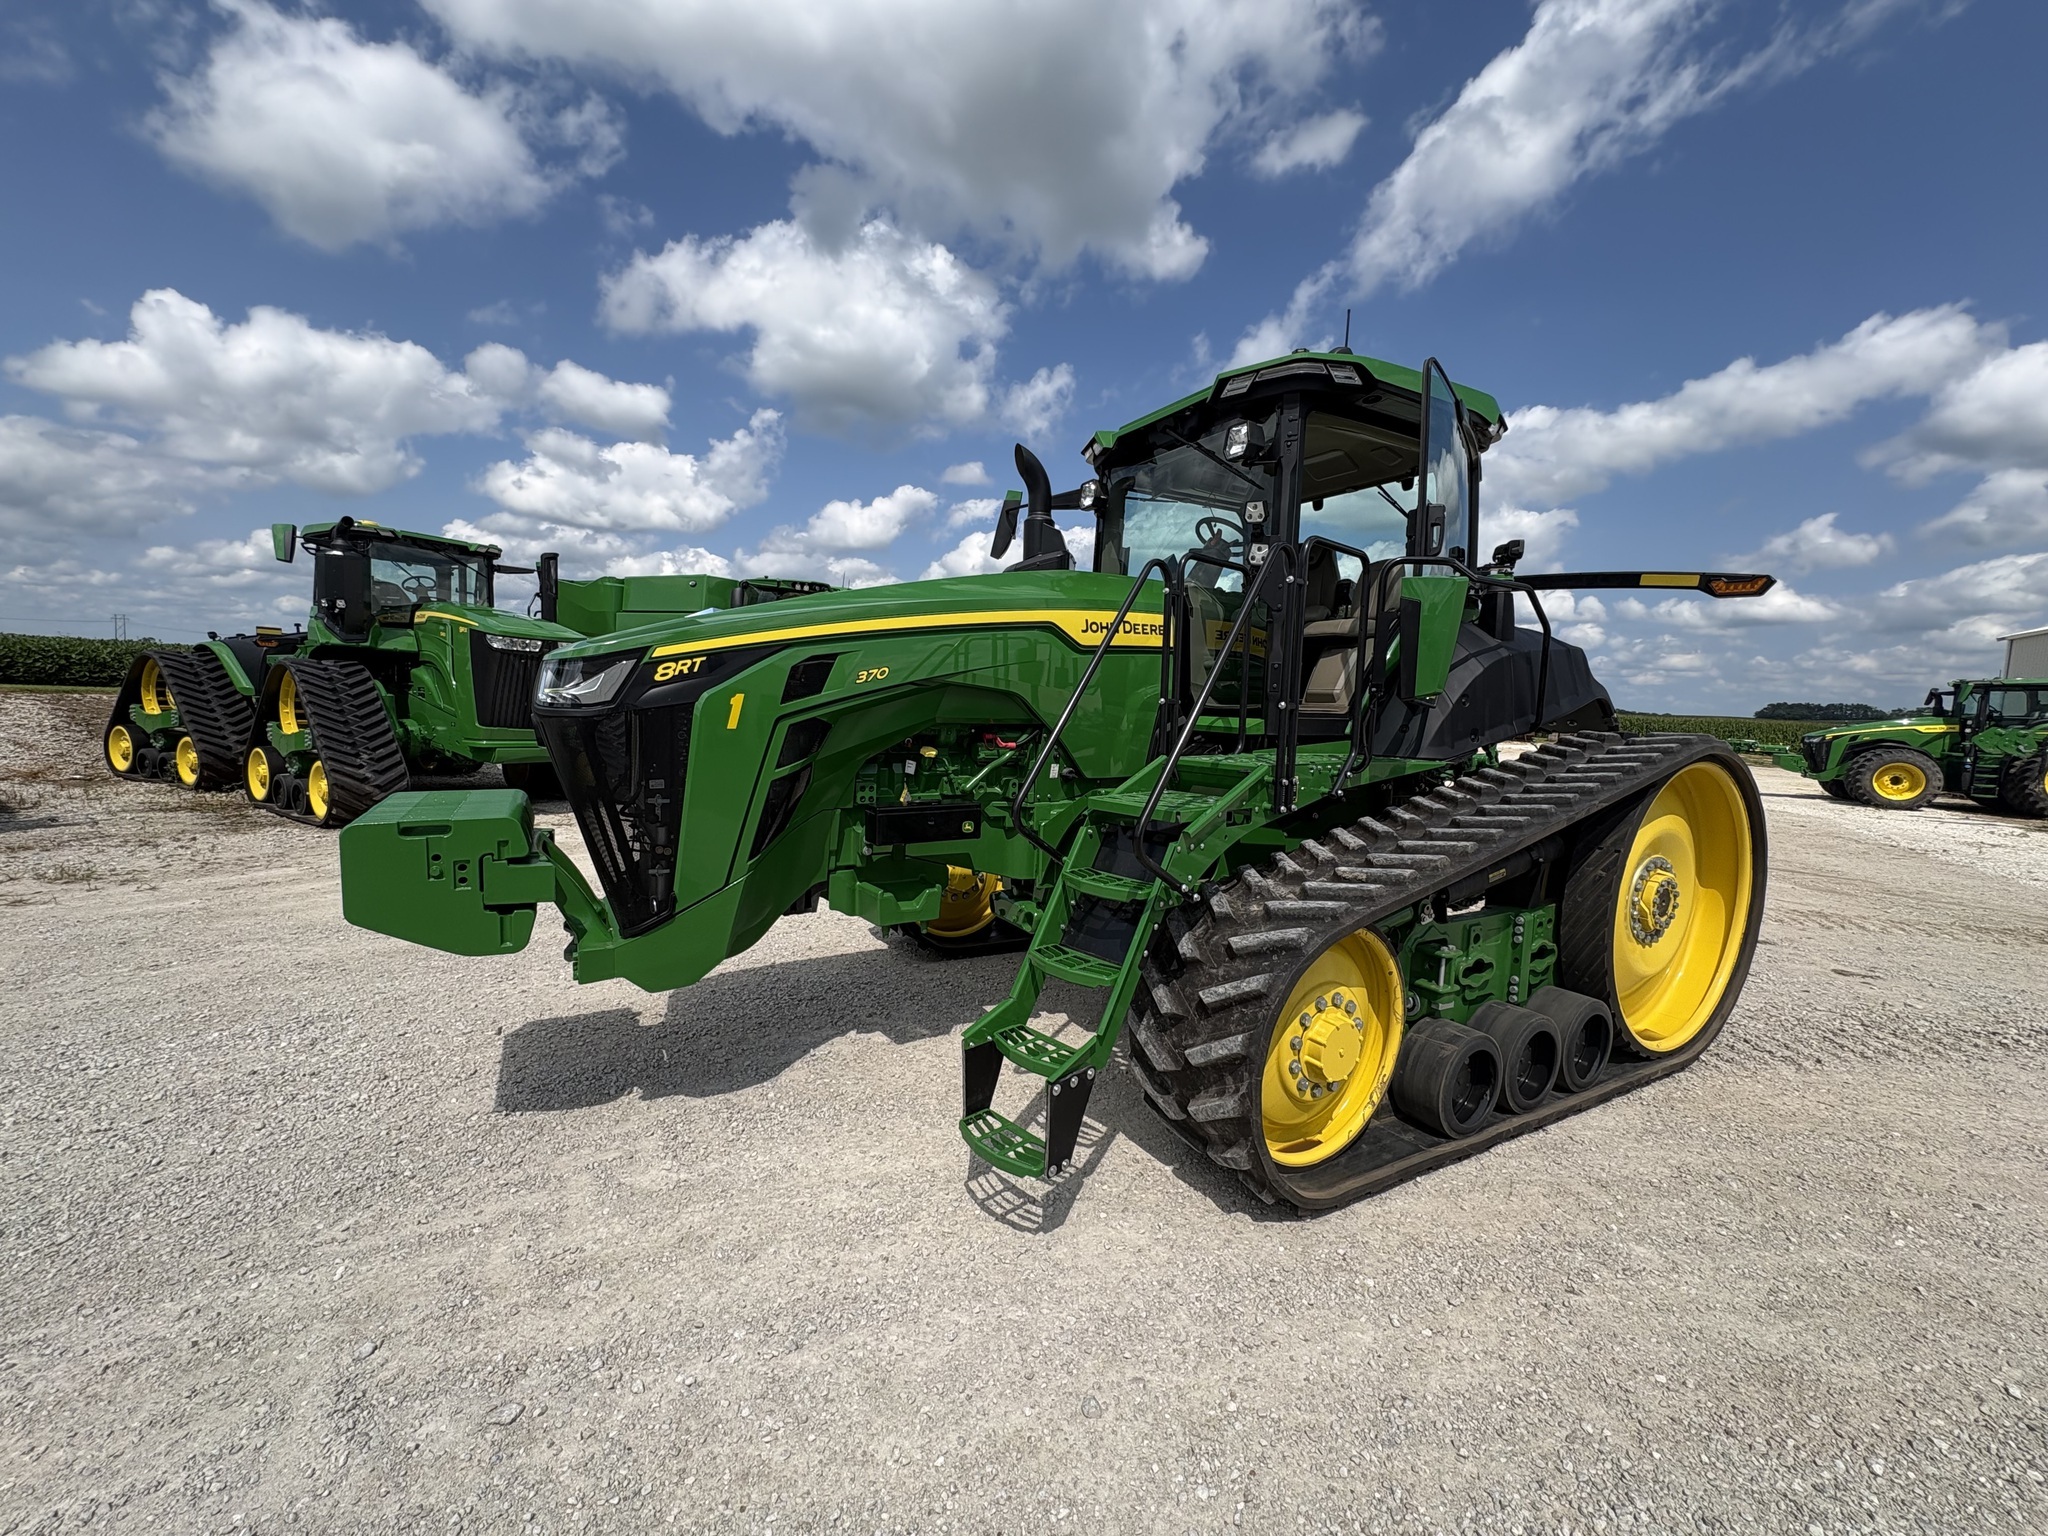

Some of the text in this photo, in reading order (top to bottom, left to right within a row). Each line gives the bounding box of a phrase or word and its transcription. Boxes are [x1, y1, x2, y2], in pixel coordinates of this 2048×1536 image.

[654, 657, 707, 681] 8RT
[856, 667, 889, 683] 370
[727, 693, 745, 729] 1
